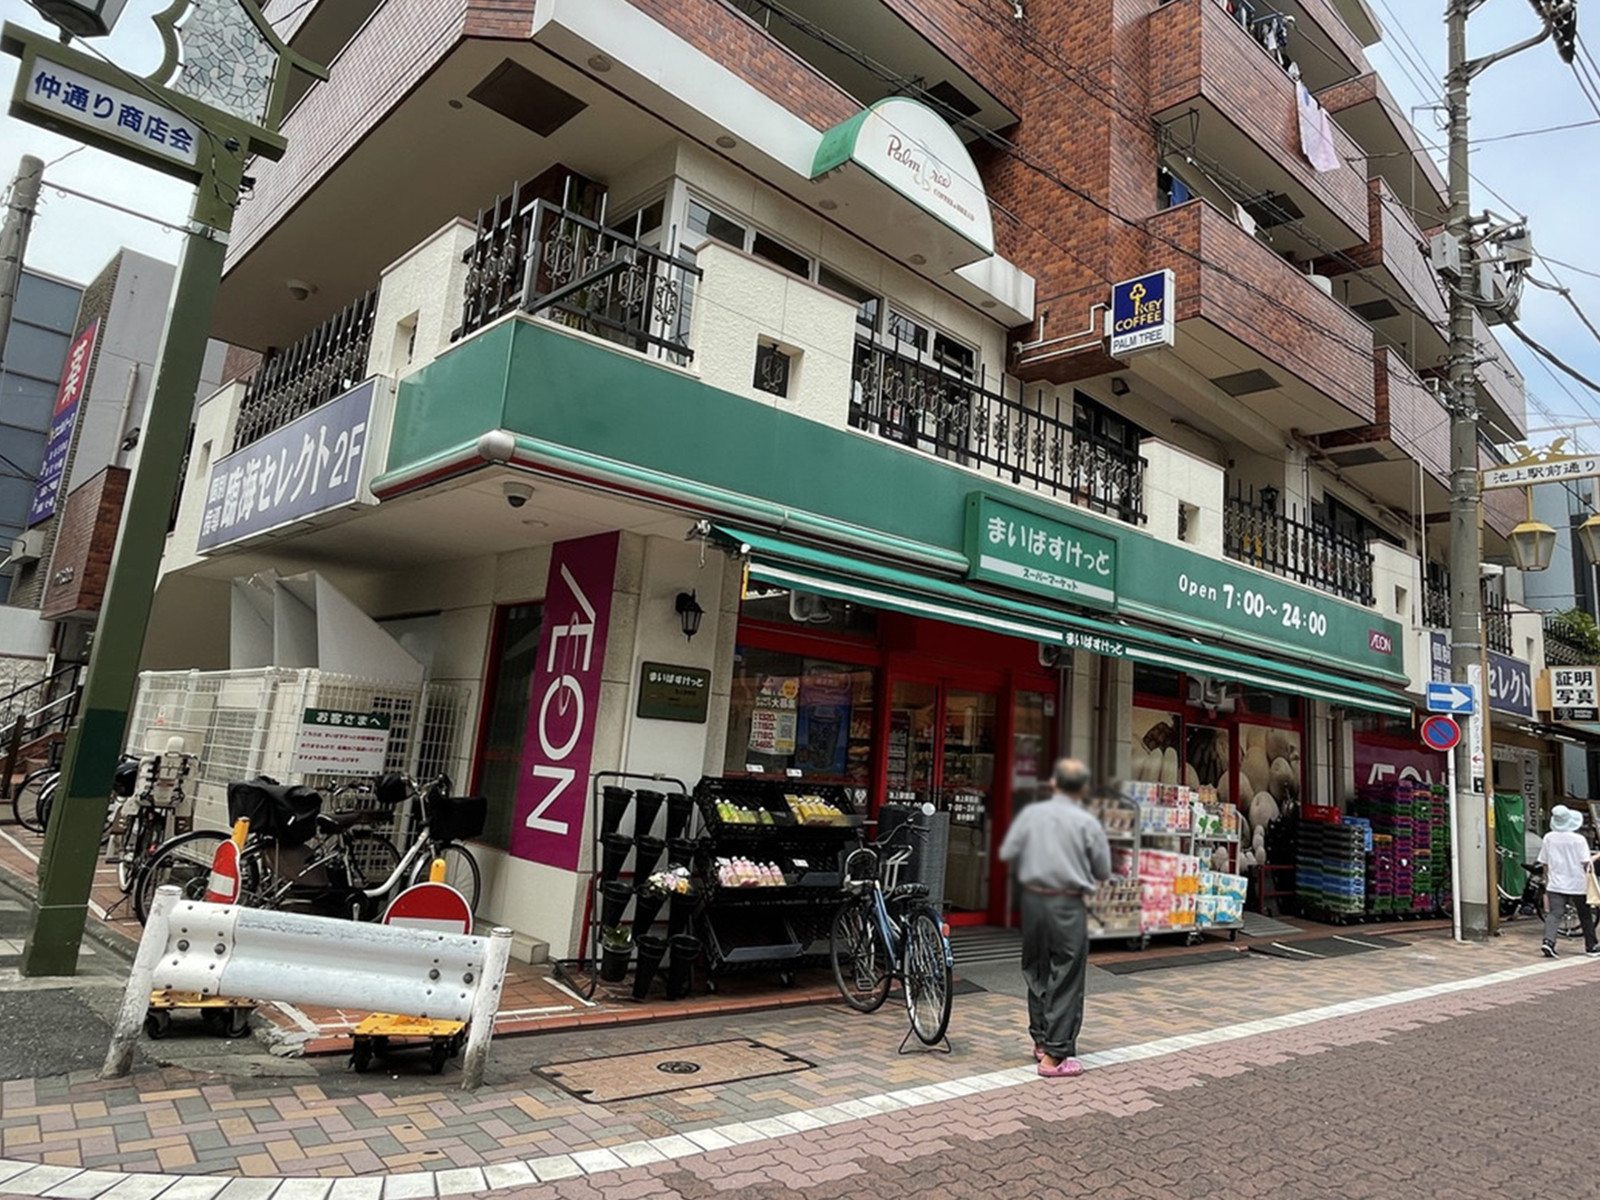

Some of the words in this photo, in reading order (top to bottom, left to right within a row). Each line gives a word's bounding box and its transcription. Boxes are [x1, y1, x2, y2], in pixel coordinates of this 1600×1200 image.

[34, 70, 193, 154] 仲通り商店会
[887, 133, 921, 172] Palm
[1139, 298, 1163, 314] KEY
[1115, 310, 1162, 331] COFFEE
[1113, 335, 1137, 350] PALM
[1138, 328, 1163, 343] TREE
[1493, 460, 1596, 484] 池上駅前通り
[987, 516, 1111, 576] まいばすけっと
[1022, 567, 1079, 589] スーパーマーケット
[1178, 573, 1217, 601] Open
[1066, 631, 1123, 656] まいばすけっと
[1555, 671, 1593, 687] 証明
[1556, 689, 1595, 705] 写真
[316, 711, 382, 727] お客さまへ
